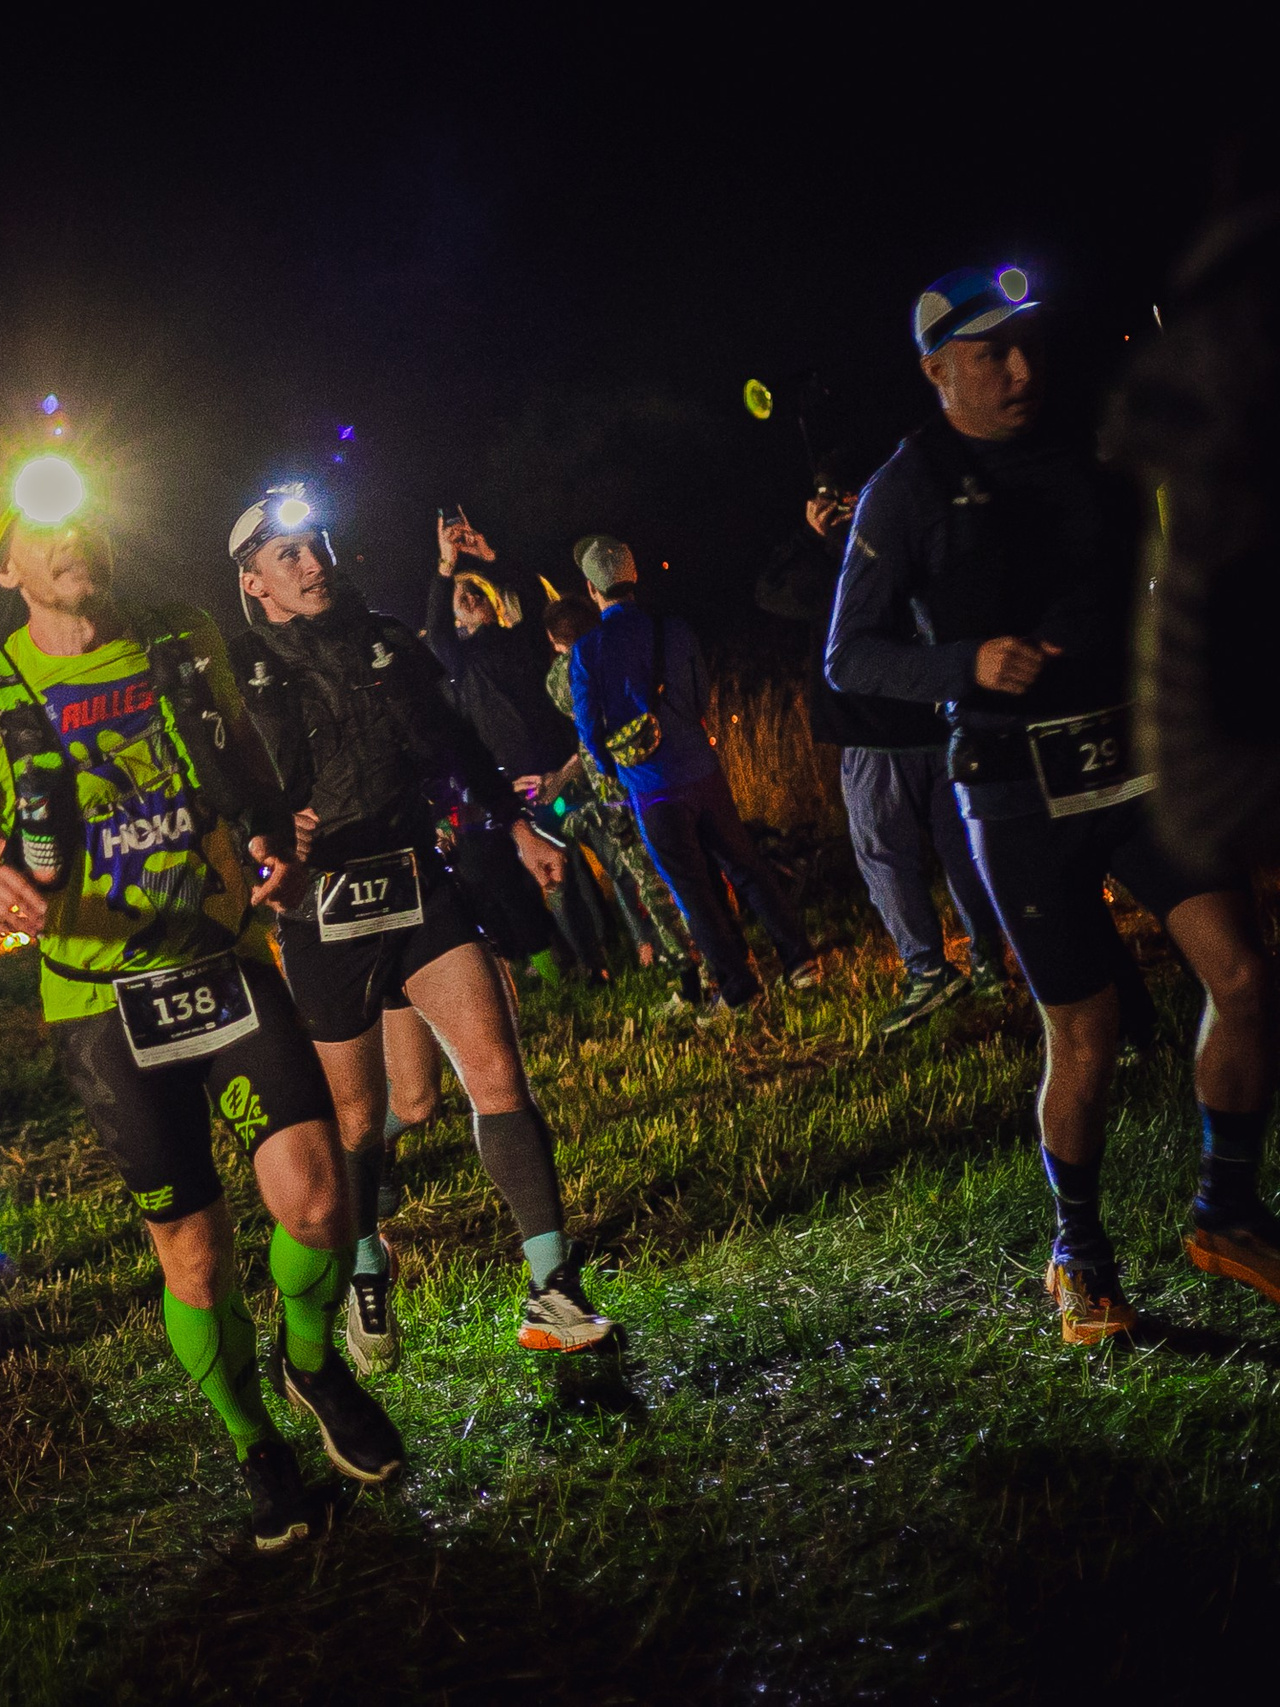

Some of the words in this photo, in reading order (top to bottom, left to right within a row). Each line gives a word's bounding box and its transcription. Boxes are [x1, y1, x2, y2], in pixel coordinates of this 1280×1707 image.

[102, 807, 194, 859] HOKA
[349, 878, 388, 905] 117
[153, 986, 216, 1026] 138
